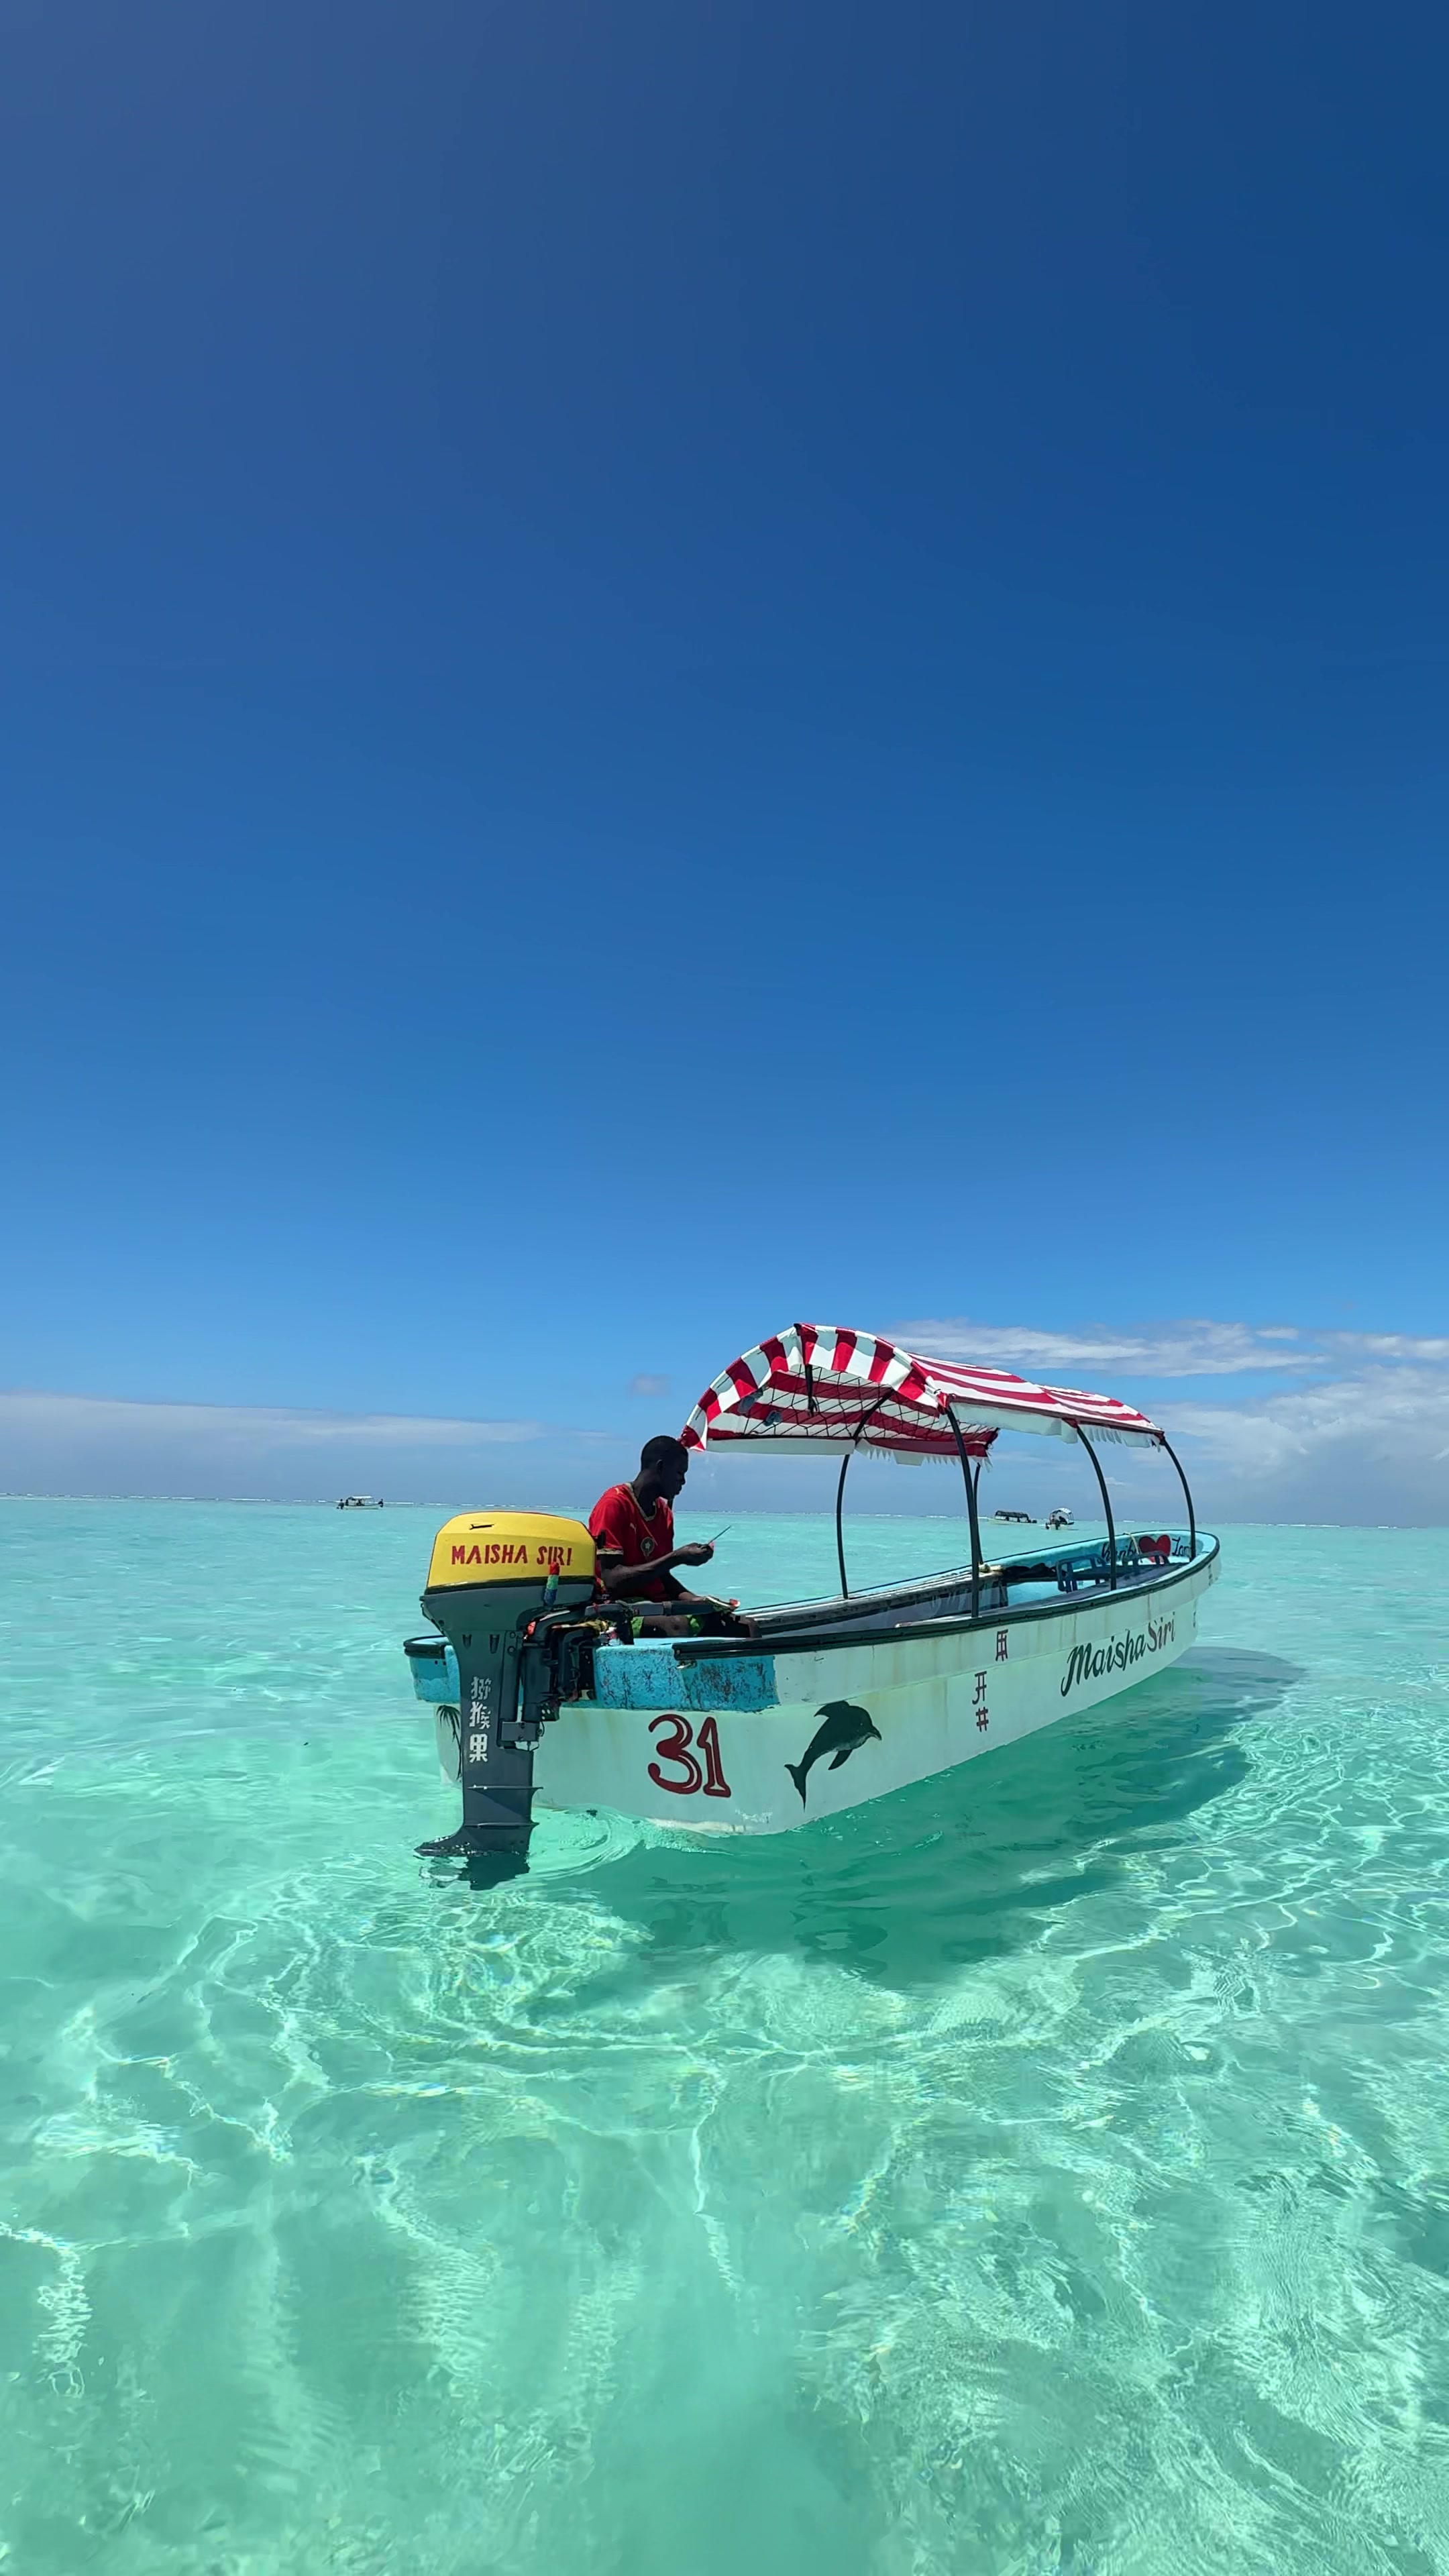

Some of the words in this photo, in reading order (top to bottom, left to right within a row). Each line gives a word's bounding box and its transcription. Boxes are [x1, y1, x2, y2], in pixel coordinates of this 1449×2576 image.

[451, 1544, 528, 1565] MAISHA
[537, 1546, 572, 1566] SIRI
[1061, 1629, 1146, 1697] Maisha
[1146, 1611, 1175, 1652] Siri
[648, 1713, 732, 1798] 31
